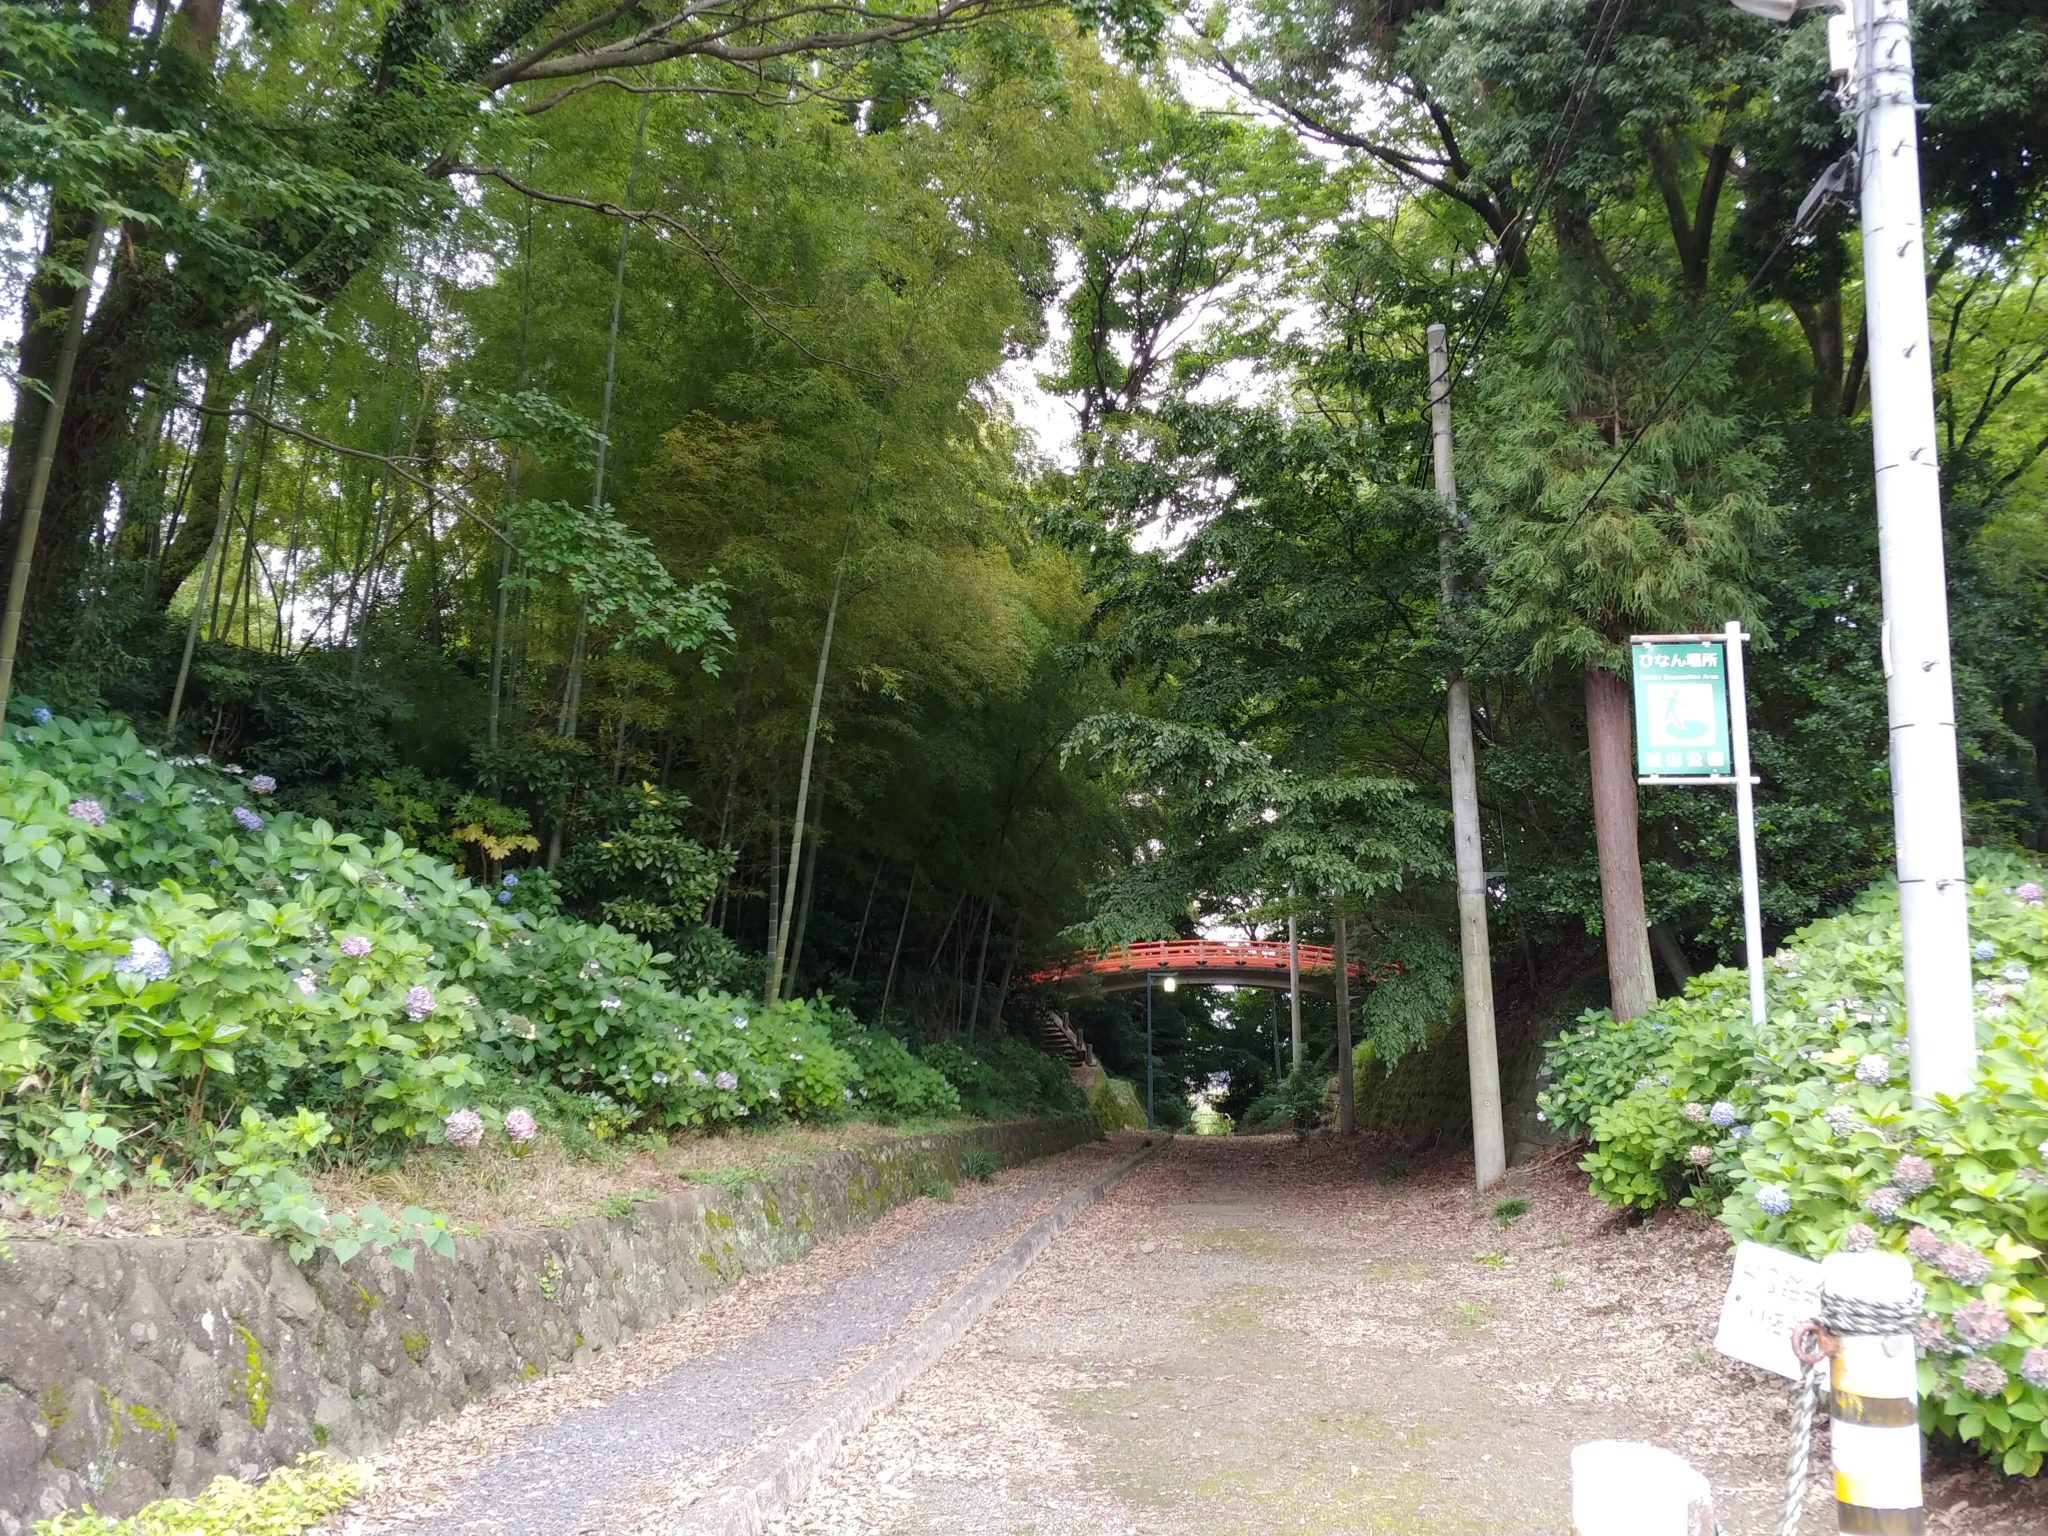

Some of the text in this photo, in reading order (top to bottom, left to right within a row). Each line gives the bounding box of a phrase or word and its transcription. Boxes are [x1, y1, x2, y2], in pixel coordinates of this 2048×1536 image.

[1639, 652, 1718, 669] ひなん場所
